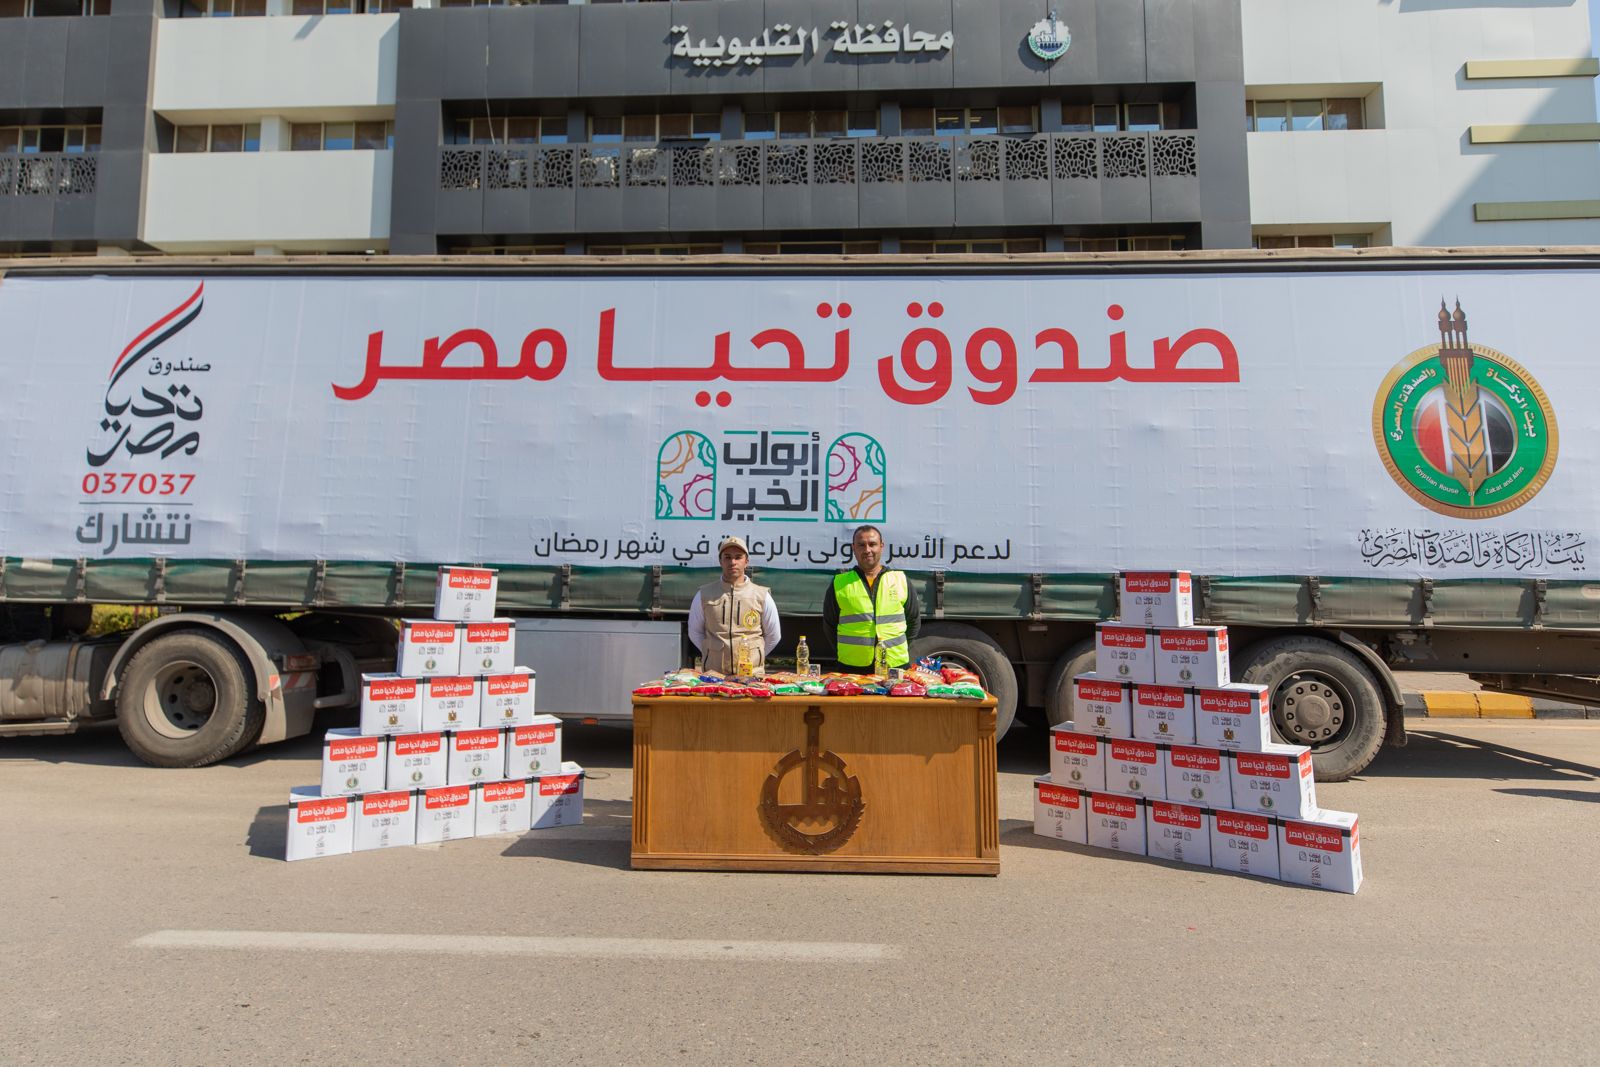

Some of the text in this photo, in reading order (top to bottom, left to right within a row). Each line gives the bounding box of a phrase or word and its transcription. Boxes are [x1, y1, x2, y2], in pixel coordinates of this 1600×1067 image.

[669, 19, 955, 67] محافظة القليوبية
[148, 357, 211, 375] صندوق
[331, 301, 1241, 407] صندوق تحيا مصر
[723, 431, 820, 476] أبواب
[82, 472, 196, 495] 037037
[721, 479, 819, 521] الخير
[76, 507, 191, 555] نتشارك
[534, 532, 608, 560] رمضان
[614, 531, 665, 560] شهر
[672, 534, 710, 566] في
[950, 538, 1011, 565] لدعم
